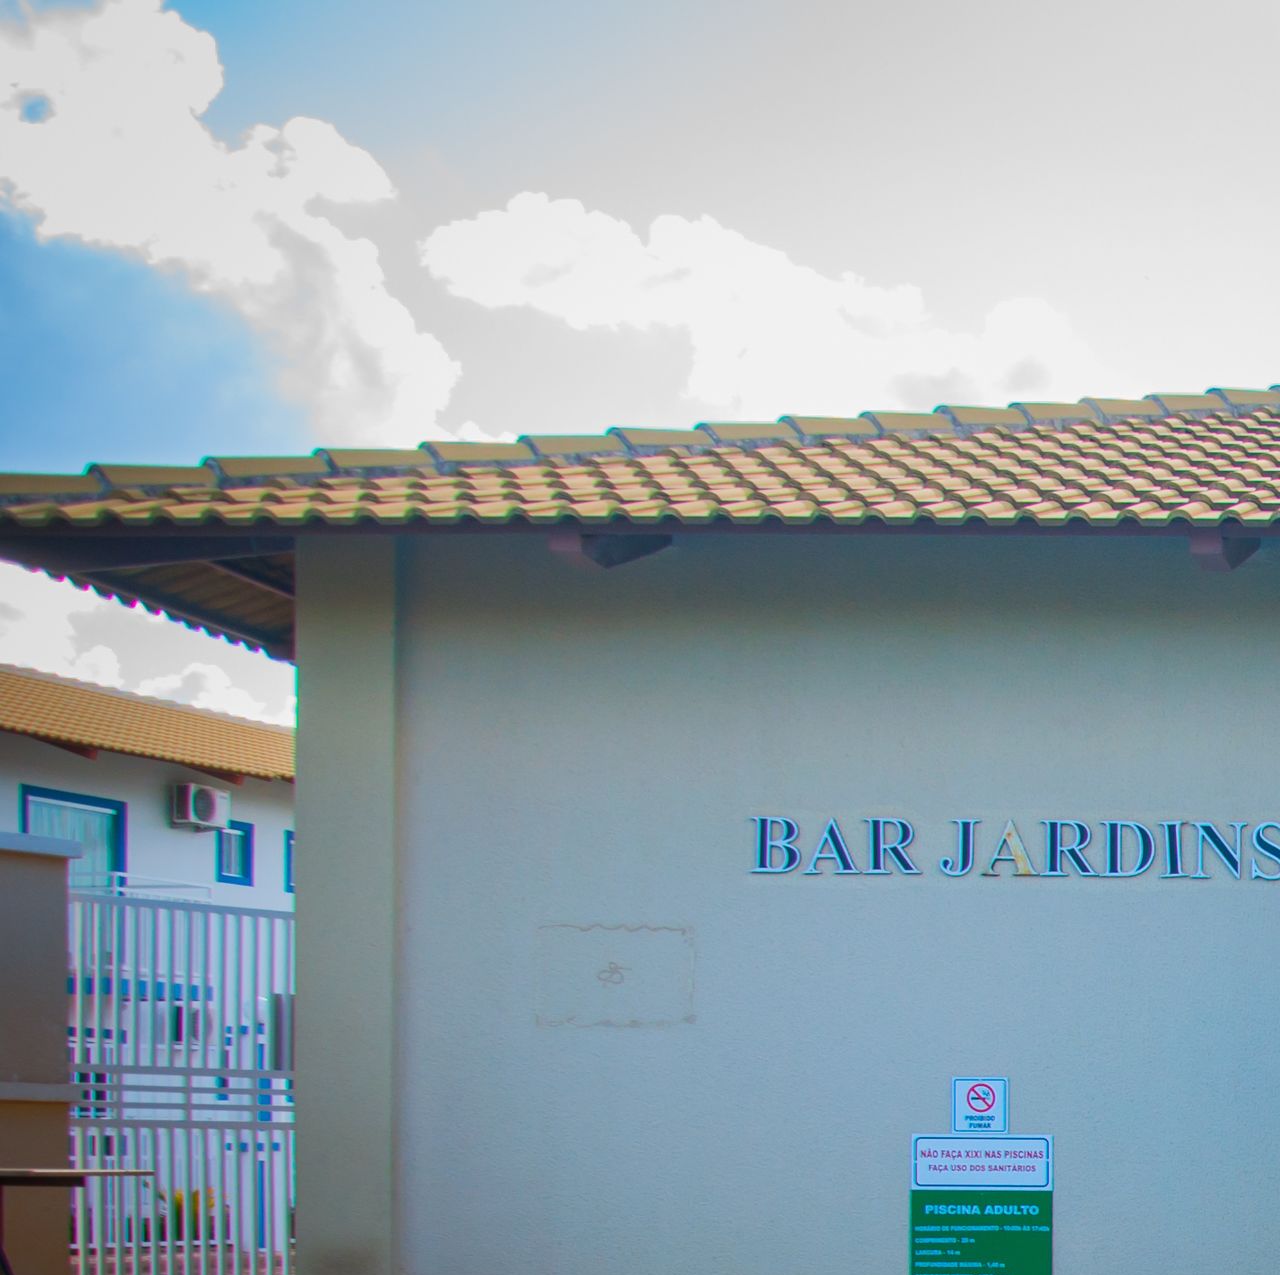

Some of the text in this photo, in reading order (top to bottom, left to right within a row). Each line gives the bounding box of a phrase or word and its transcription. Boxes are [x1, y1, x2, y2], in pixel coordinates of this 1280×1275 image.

[748, 815, 924, 876] BAR
[921, 1148, 1044, 1160] NÃO FAÇA XIXI NAS PISCINAS
[928, 1164, 948, 1173] FAÇA
[925, 1204, 1040, 1216] PISCINA ADULTO
